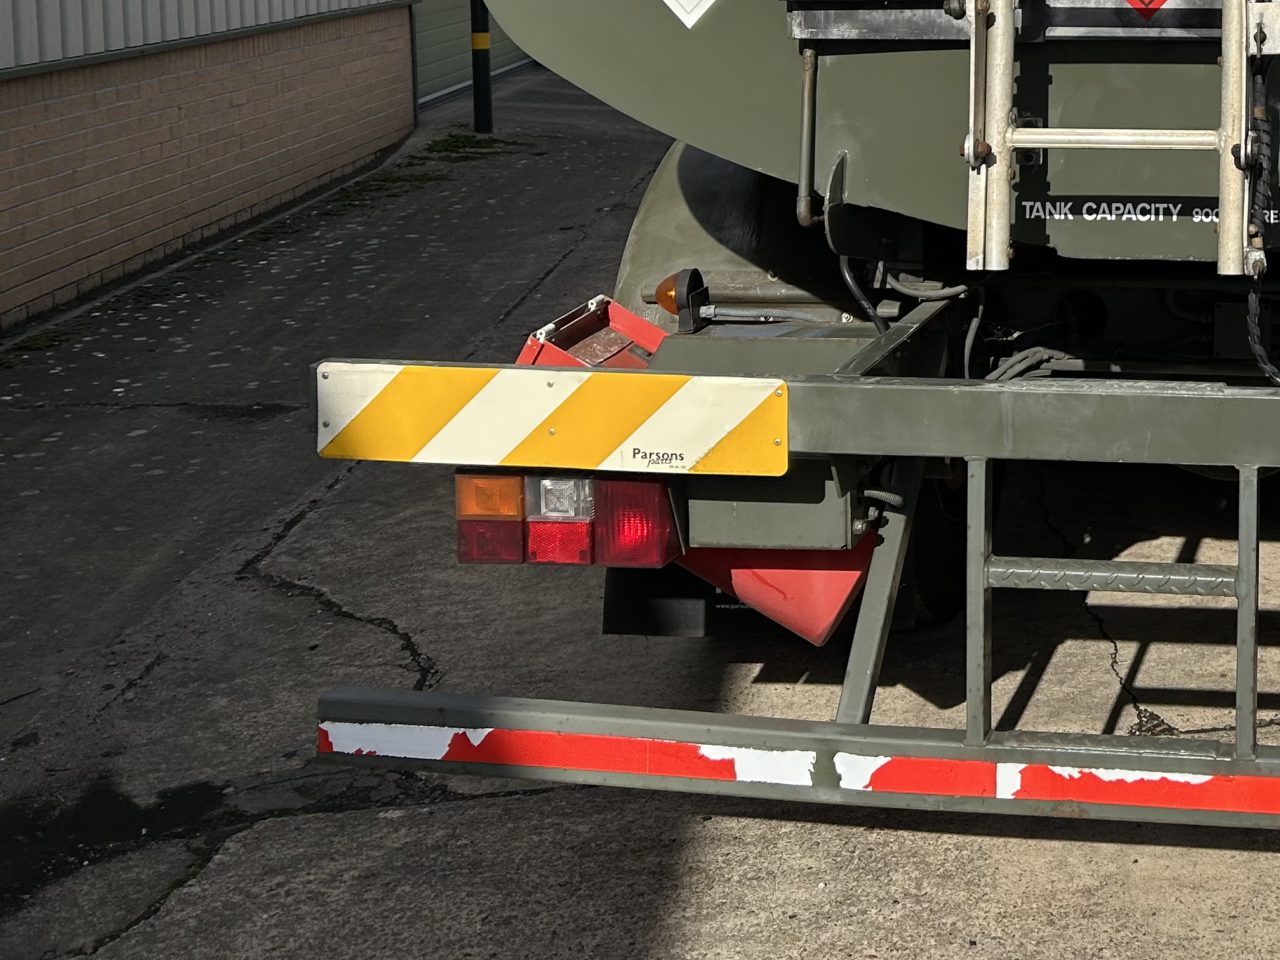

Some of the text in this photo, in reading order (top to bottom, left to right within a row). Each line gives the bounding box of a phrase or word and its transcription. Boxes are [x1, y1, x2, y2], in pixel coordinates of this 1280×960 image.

[1021, 200, 1074, 220] TANK
[1082, 201, 1183, 222] CAPACITY
[632, 447, 685, 461] Parsons
